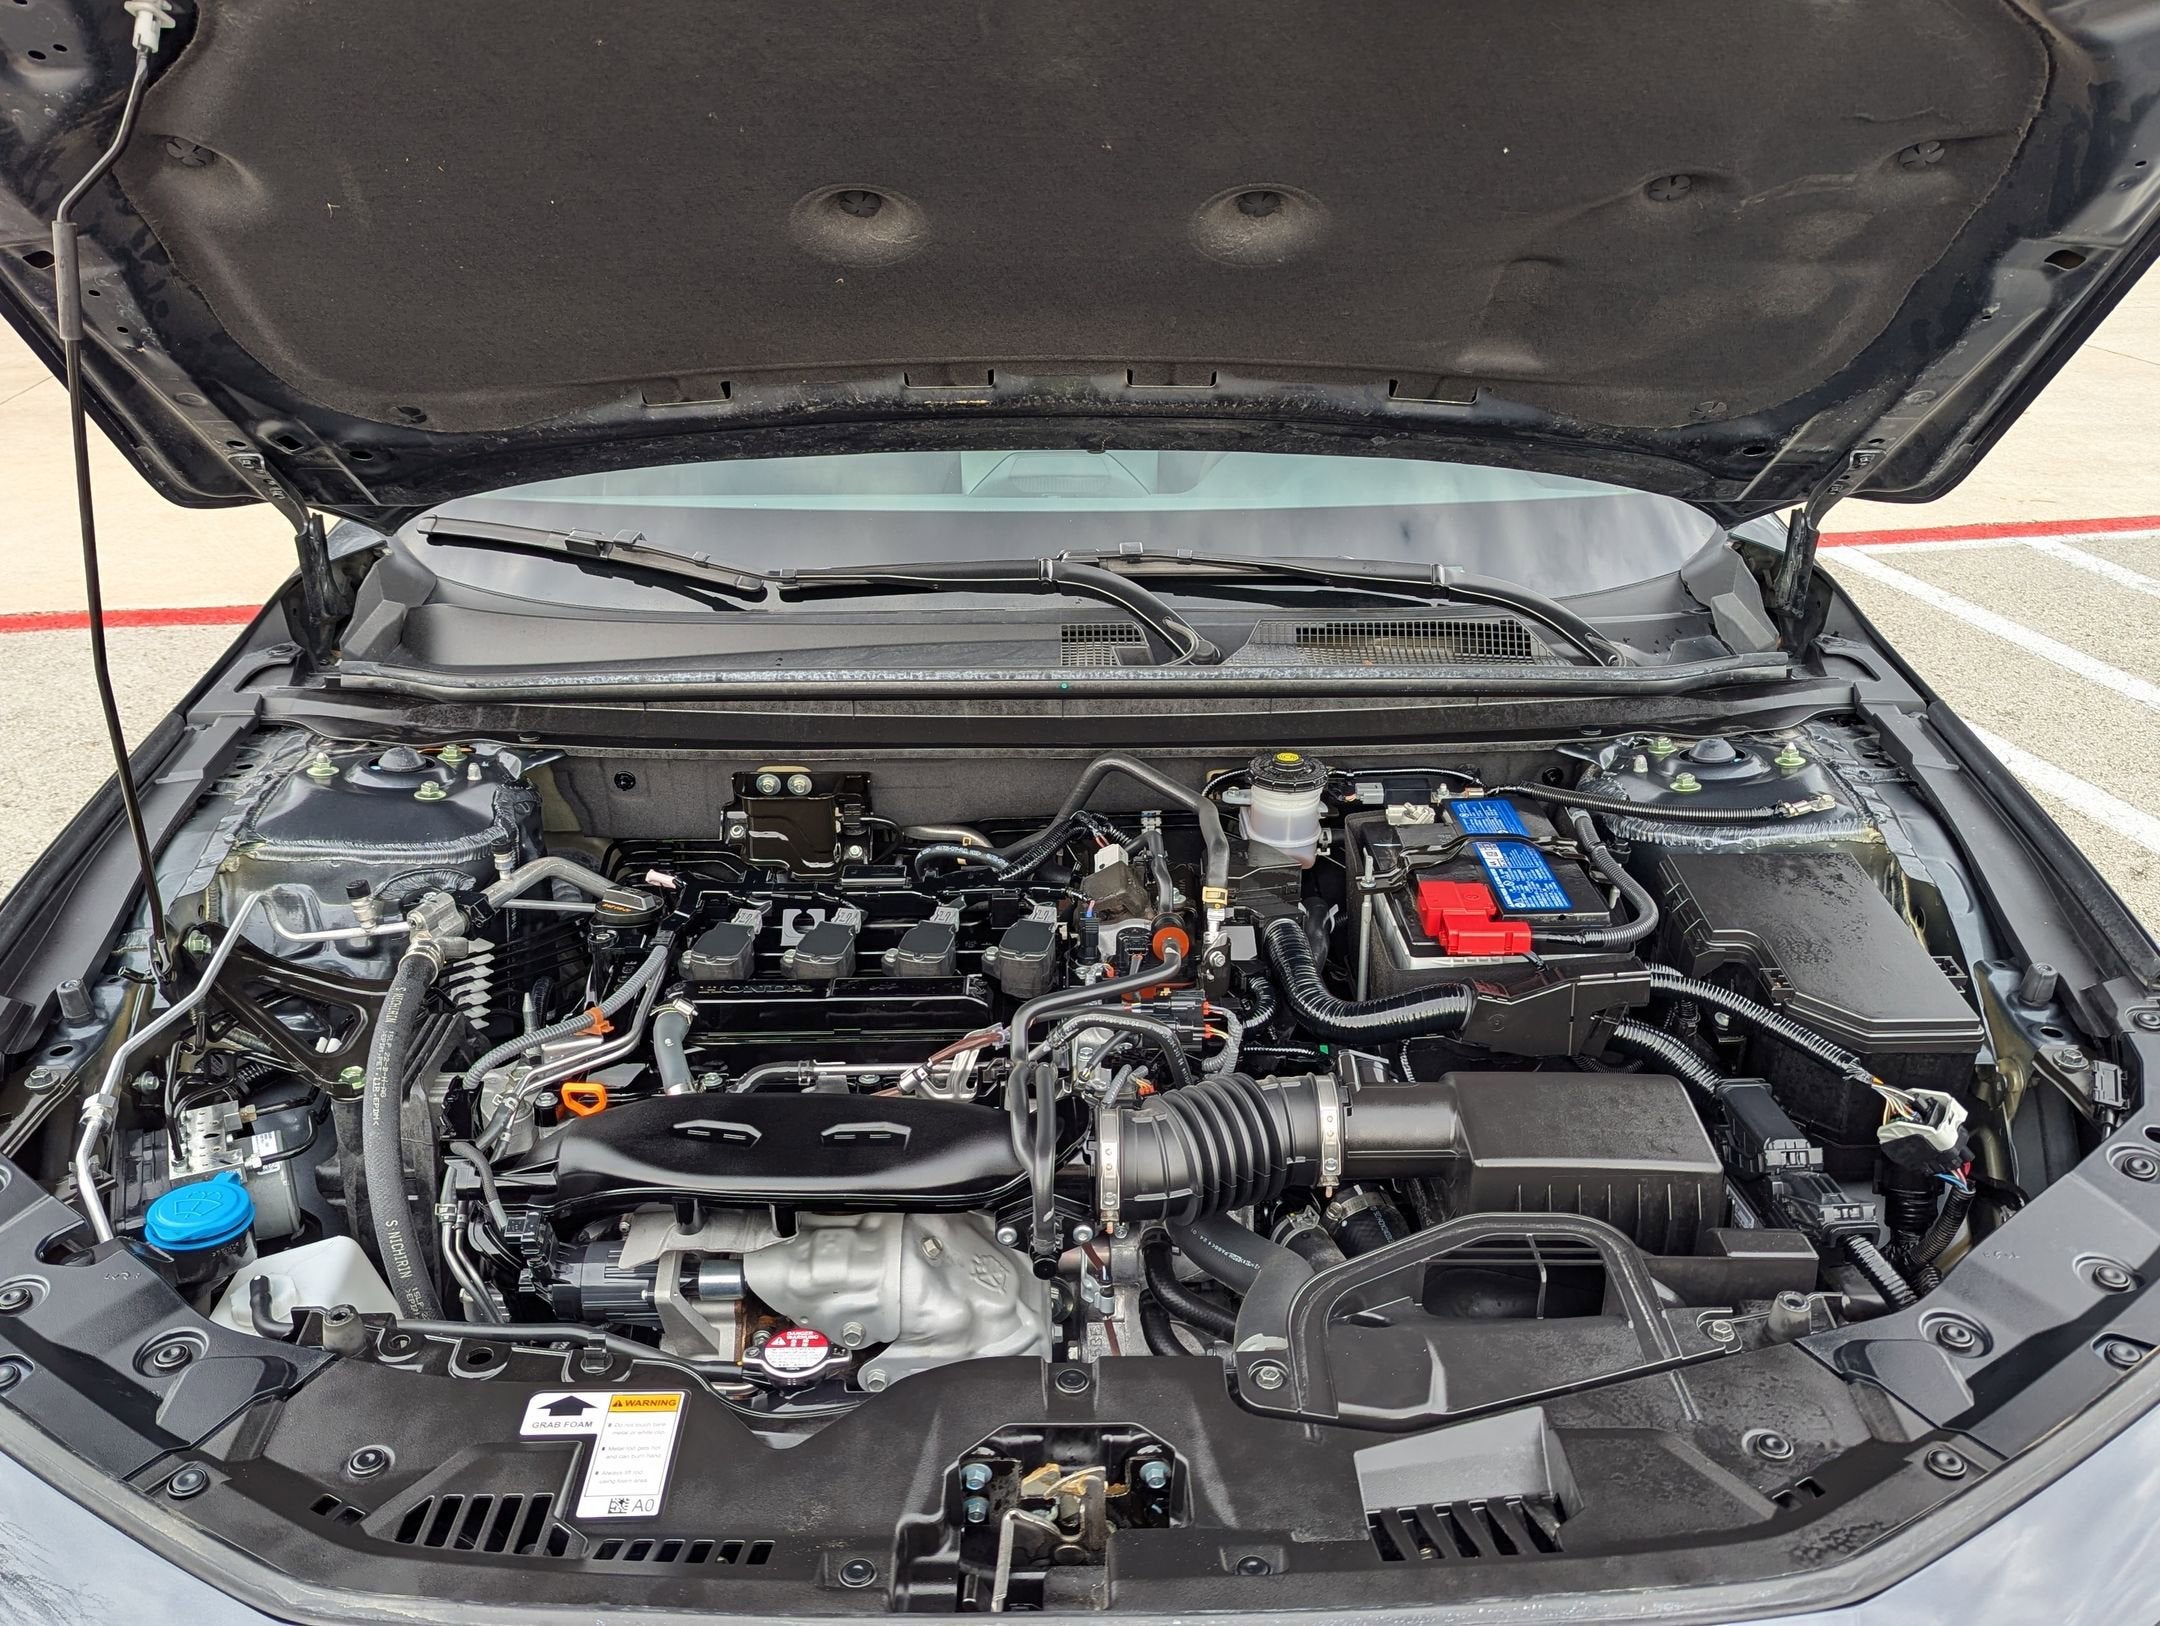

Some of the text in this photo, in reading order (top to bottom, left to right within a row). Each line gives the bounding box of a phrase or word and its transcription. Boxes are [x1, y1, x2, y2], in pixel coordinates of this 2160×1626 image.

[625, 1399, 677, 1407] WARNING
[532, 1421, 561, 1429] GRAB
[632, 1499, 655, 1512] A0
